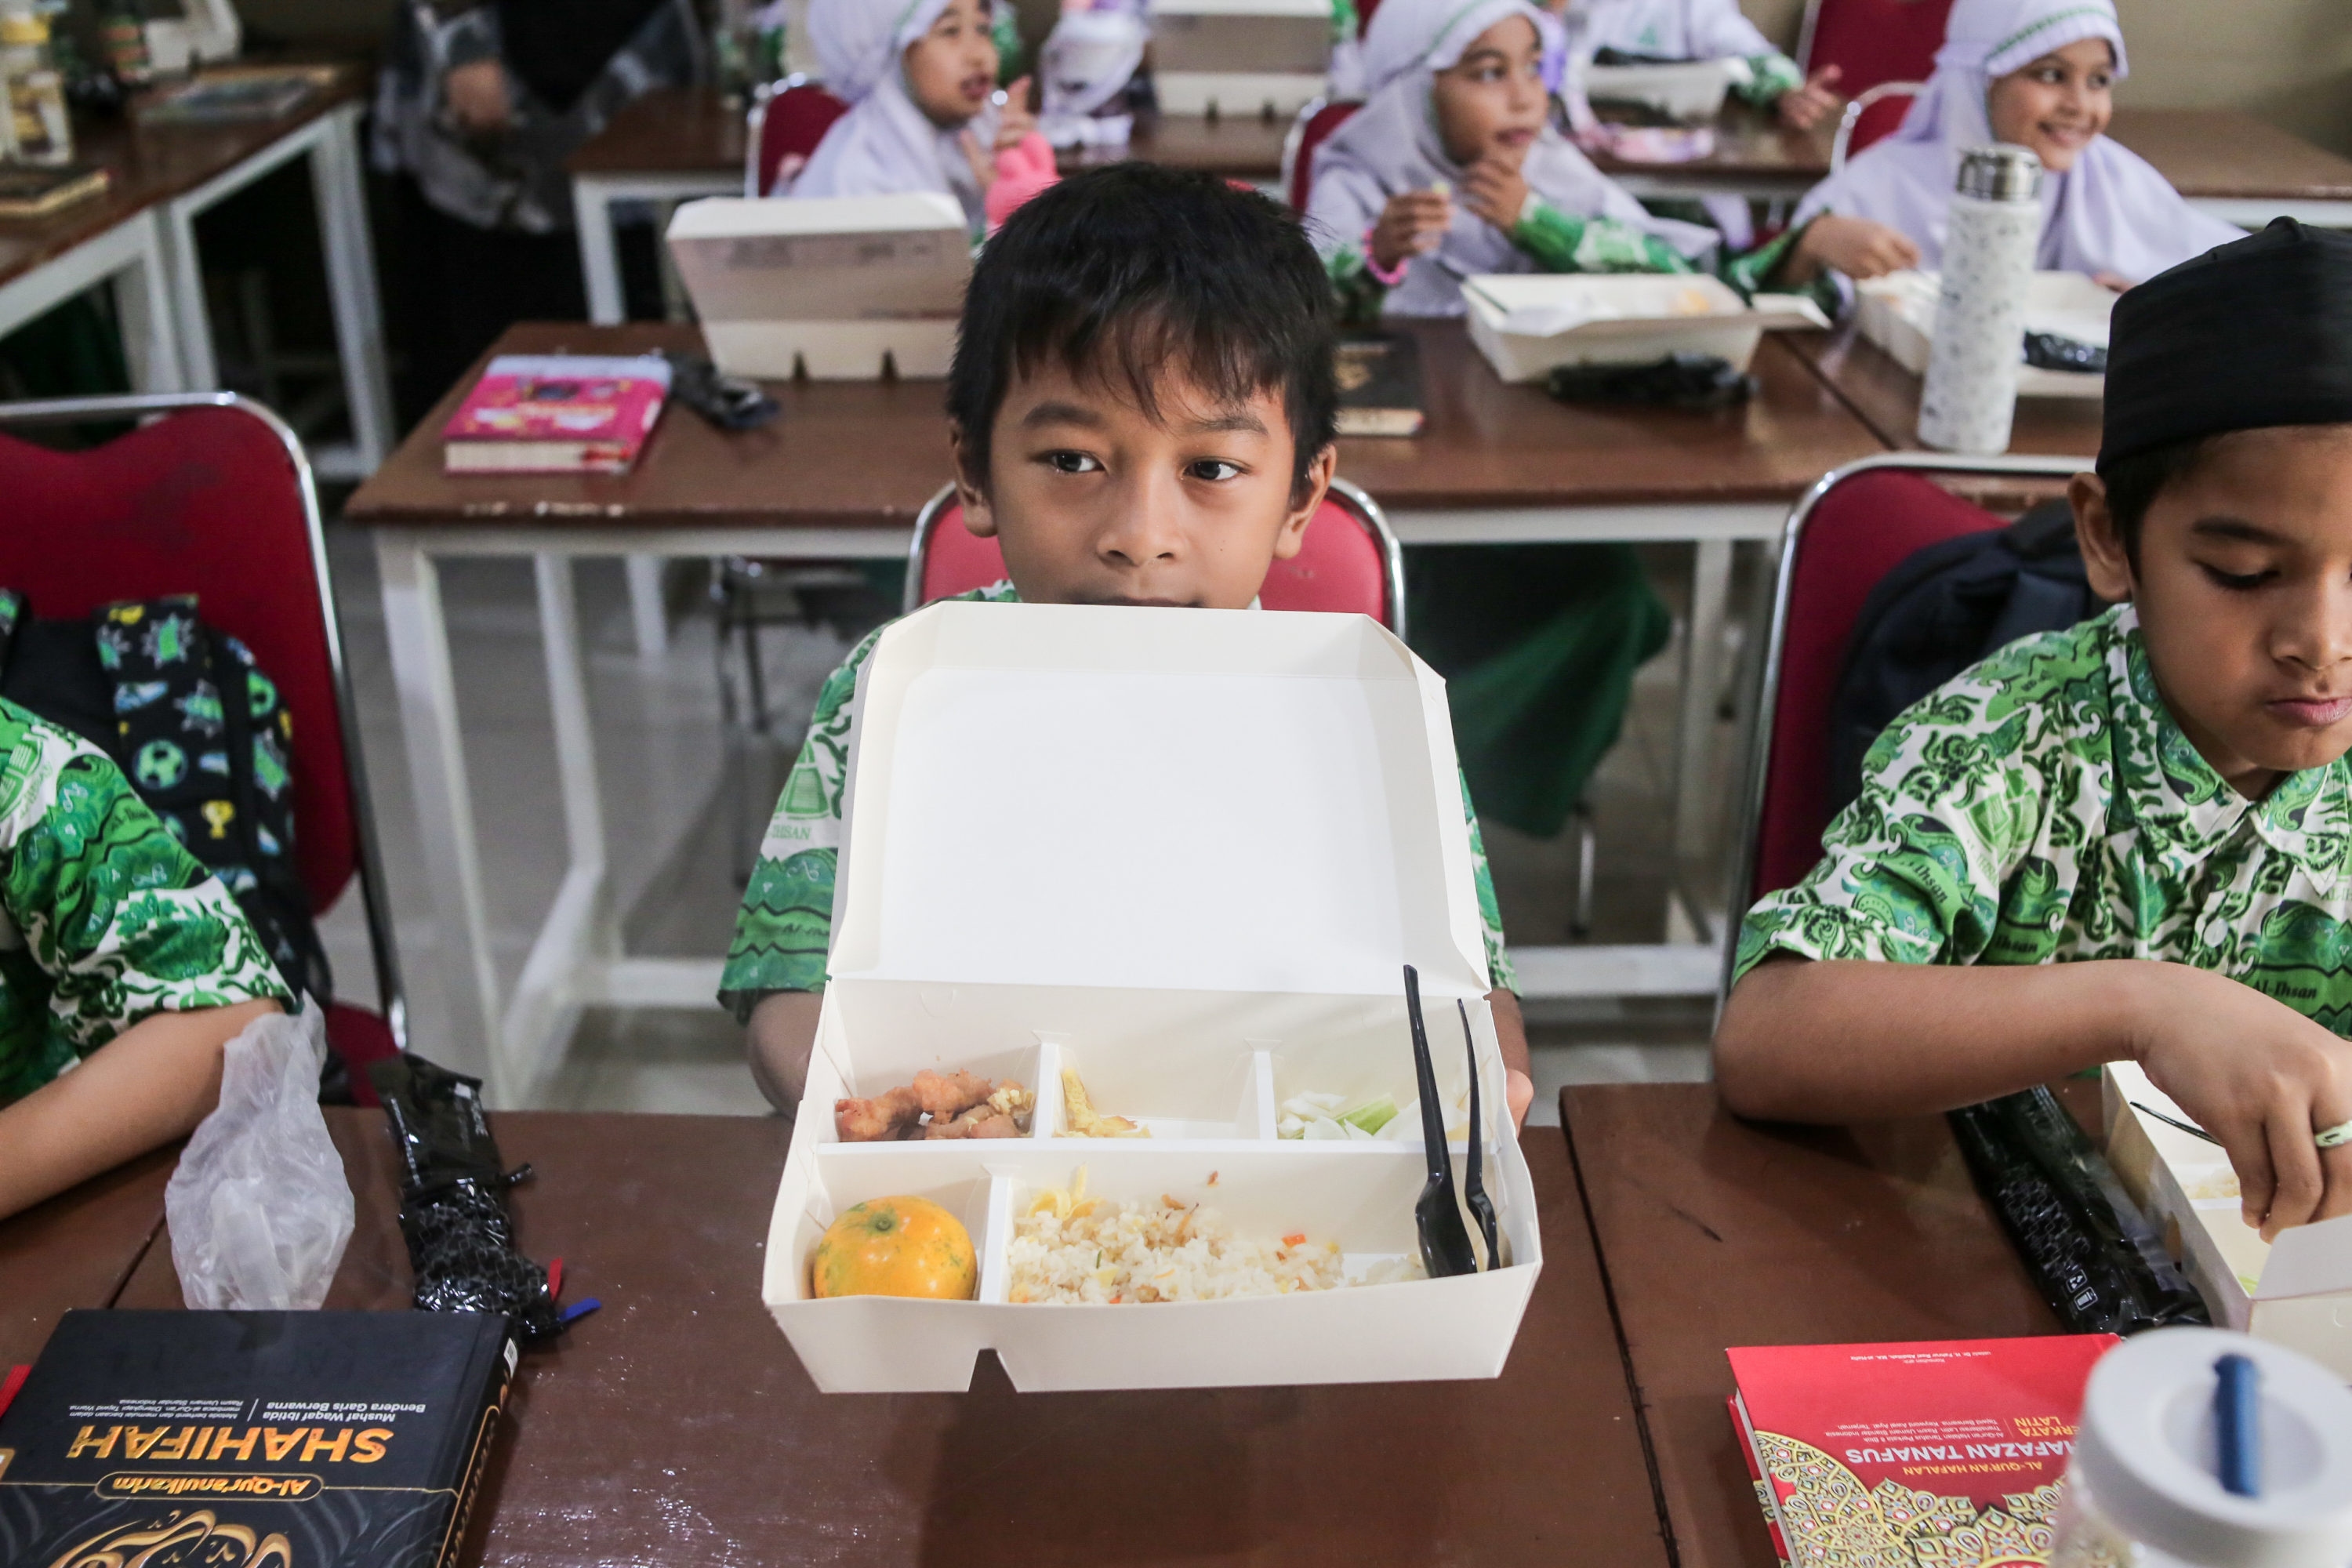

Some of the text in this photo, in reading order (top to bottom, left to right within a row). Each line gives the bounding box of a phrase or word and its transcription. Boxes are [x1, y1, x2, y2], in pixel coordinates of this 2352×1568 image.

[2253, 979, 2317, 998] Al-Ihsan
[267, 1402, 426, 1413] Bendera Garis Berwarna
[263, 1411, 396, 1422] Mushaf Waqaf Ibtida
[2013, 1416, 2062, 1427] LATIN
[66, 1425, 394, 1463] SHAHIFAH
[1845, 1444, 1964, 1464] TANAFUS
[1902, 1461, 2042, 1475] AL-QUR'AN HAFALAN
[112, 1476, 312, 1497] Al-Qur'anulkarim
